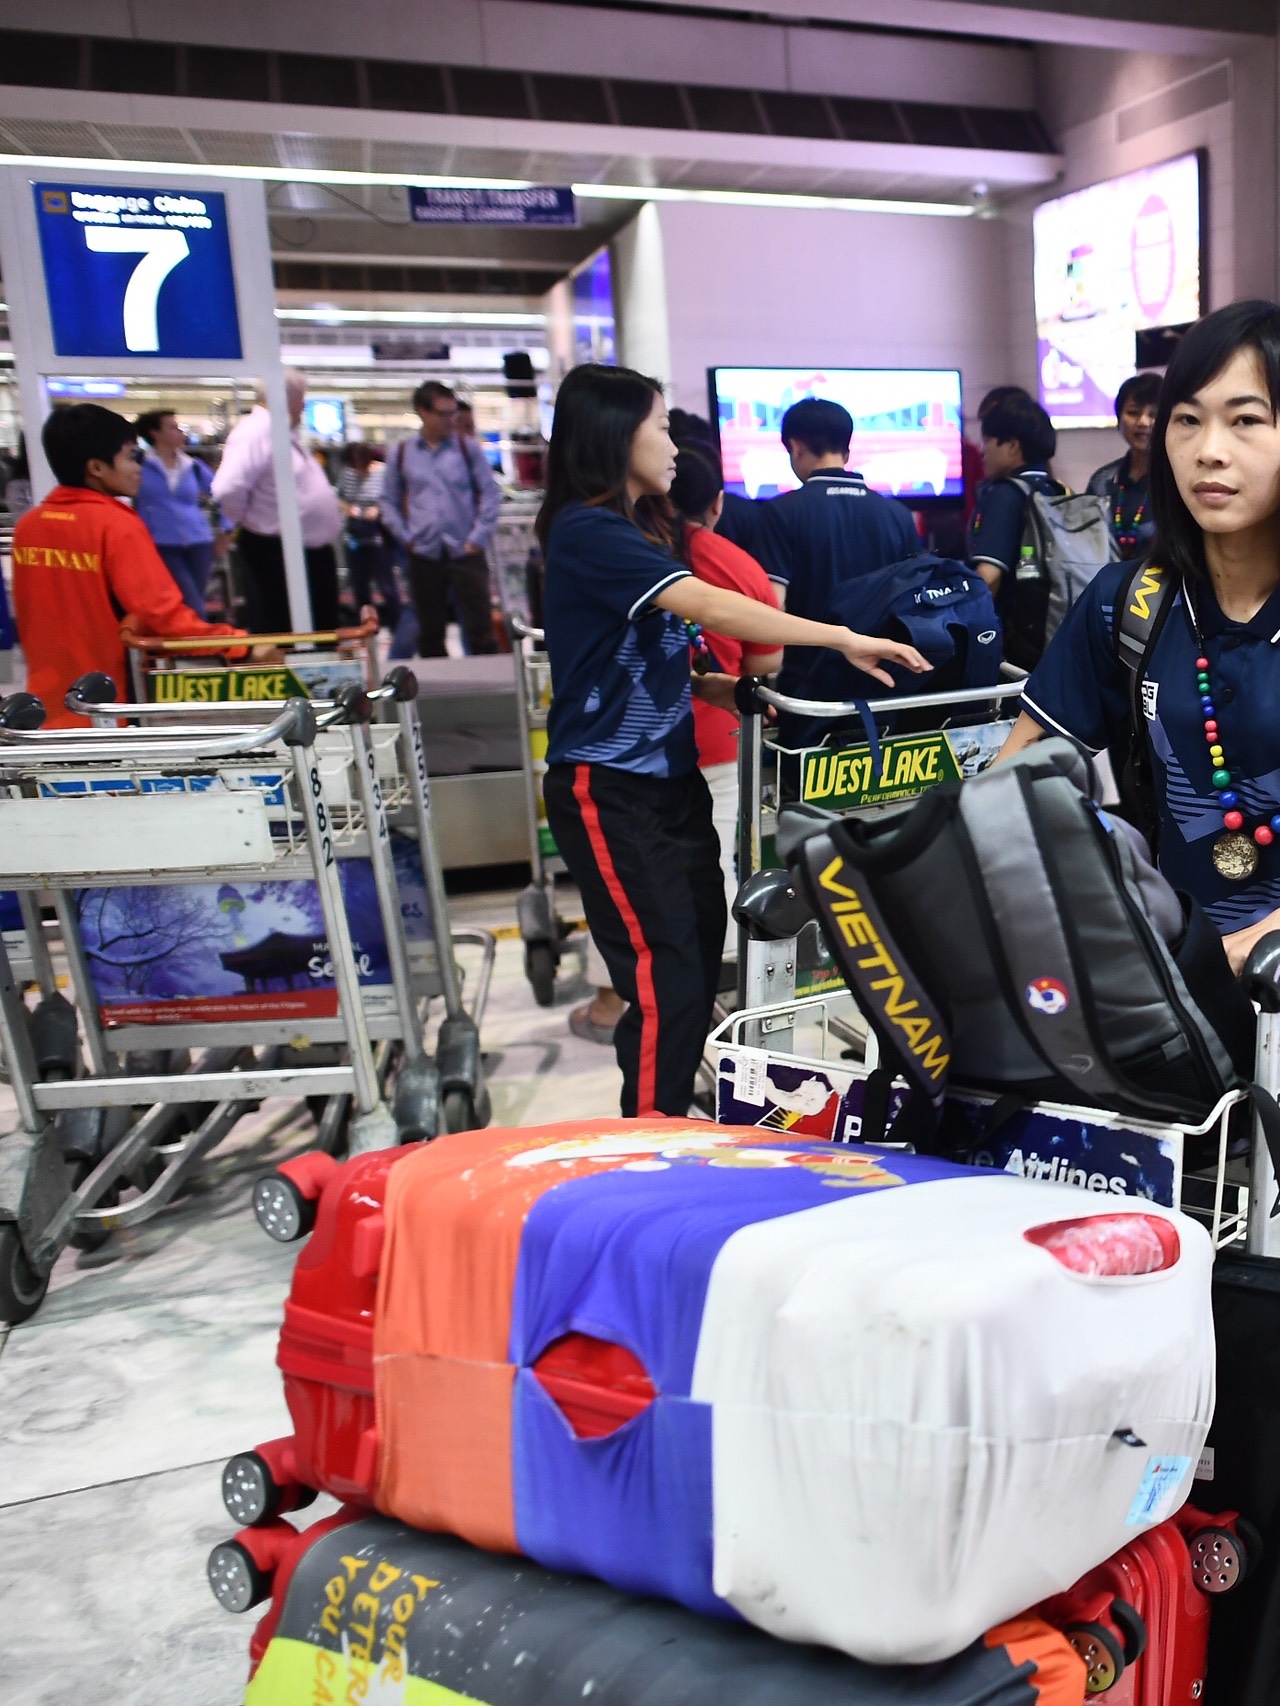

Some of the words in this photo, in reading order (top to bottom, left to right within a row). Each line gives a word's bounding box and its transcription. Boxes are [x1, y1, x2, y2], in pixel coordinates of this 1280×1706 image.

[85, 226, 190, 352] 7
[155, 673, 223, 703] WEST
[228, 671, 289, 700] LAKE
[804, 755, 873, 801] WEST
[879, 745, 942, 789] LAKE
[310, 766, 334, 868] 882
[308, 953, 375, 979] Sel
[819, 855, 951, 1081] VIETNAM
[1004, 1148, 1128, 1197] Airlines
[345, 1561, 402, 1706] DETER
